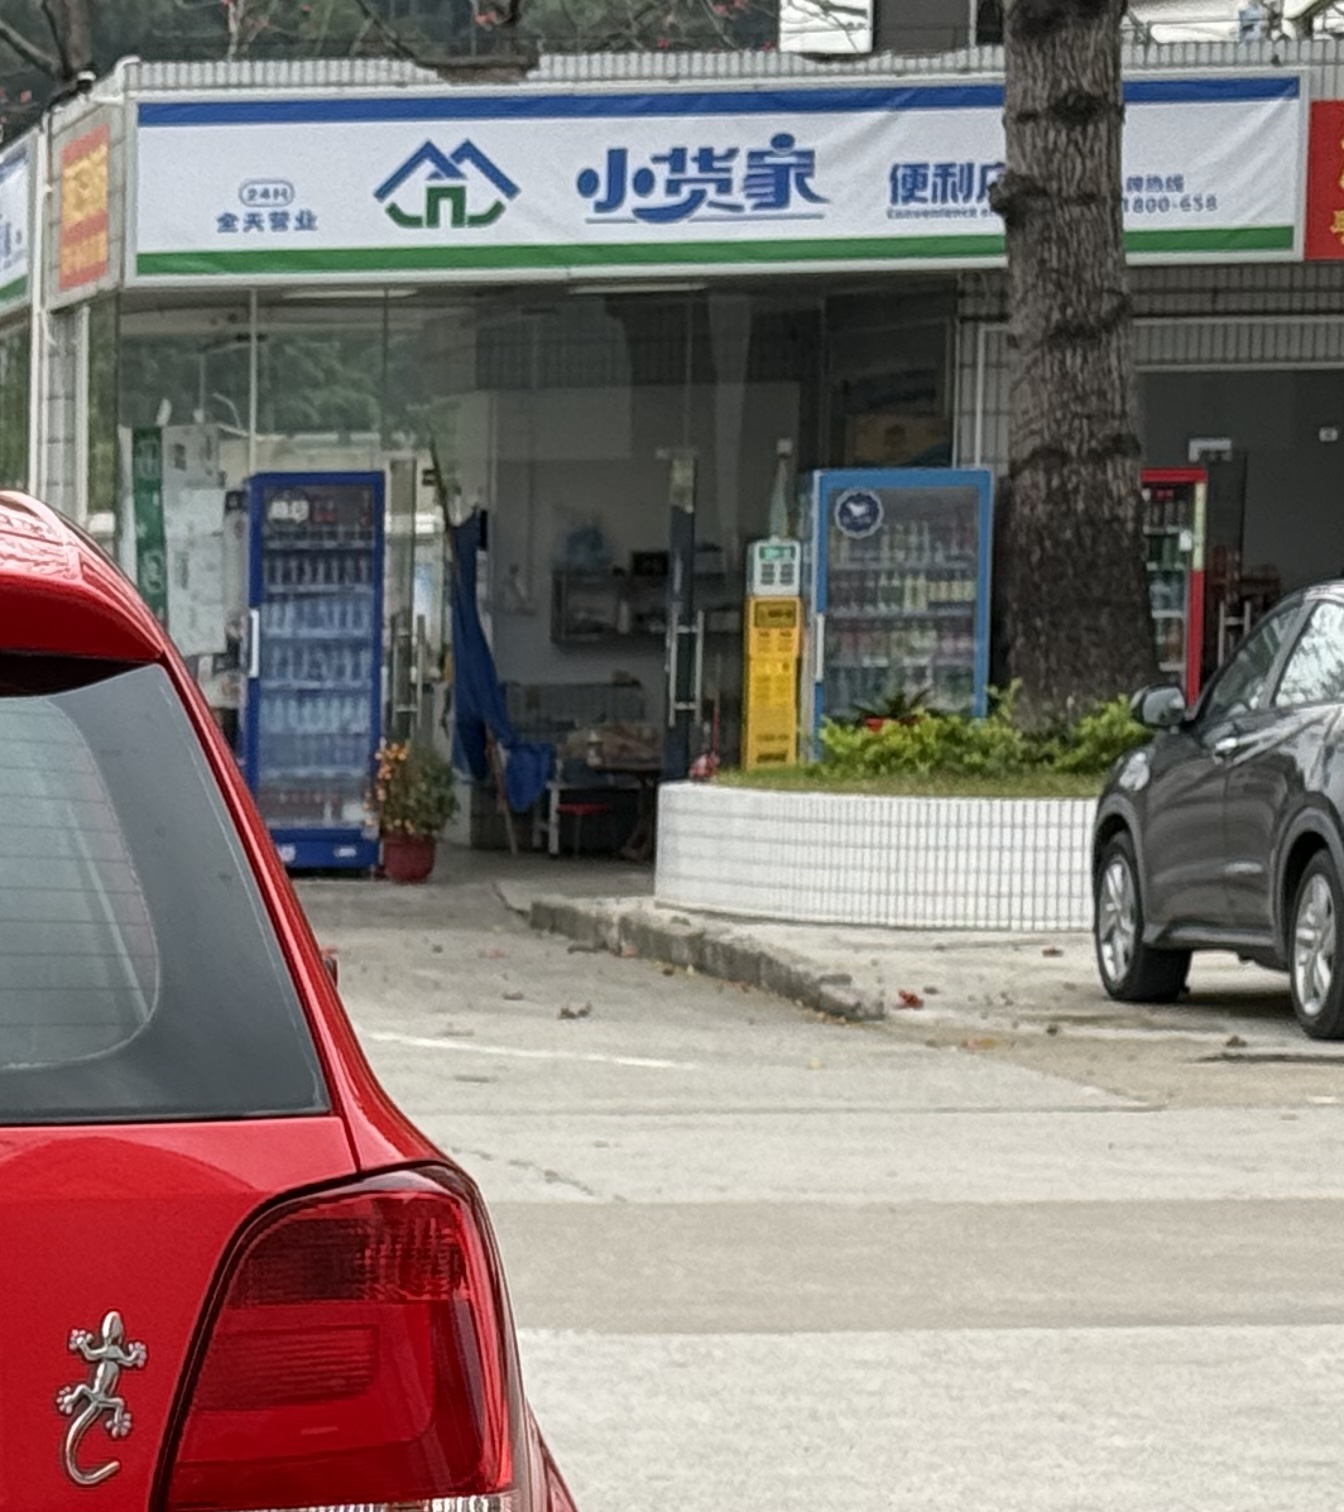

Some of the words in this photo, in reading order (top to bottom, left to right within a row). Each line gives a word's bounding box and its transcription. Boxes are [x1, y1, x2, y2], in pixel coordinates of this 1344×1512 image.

[576, 132, 830, 223] 小货家
[246, 186, 290, 201] 24H
[215, 208, 318, 233] 全天营业
